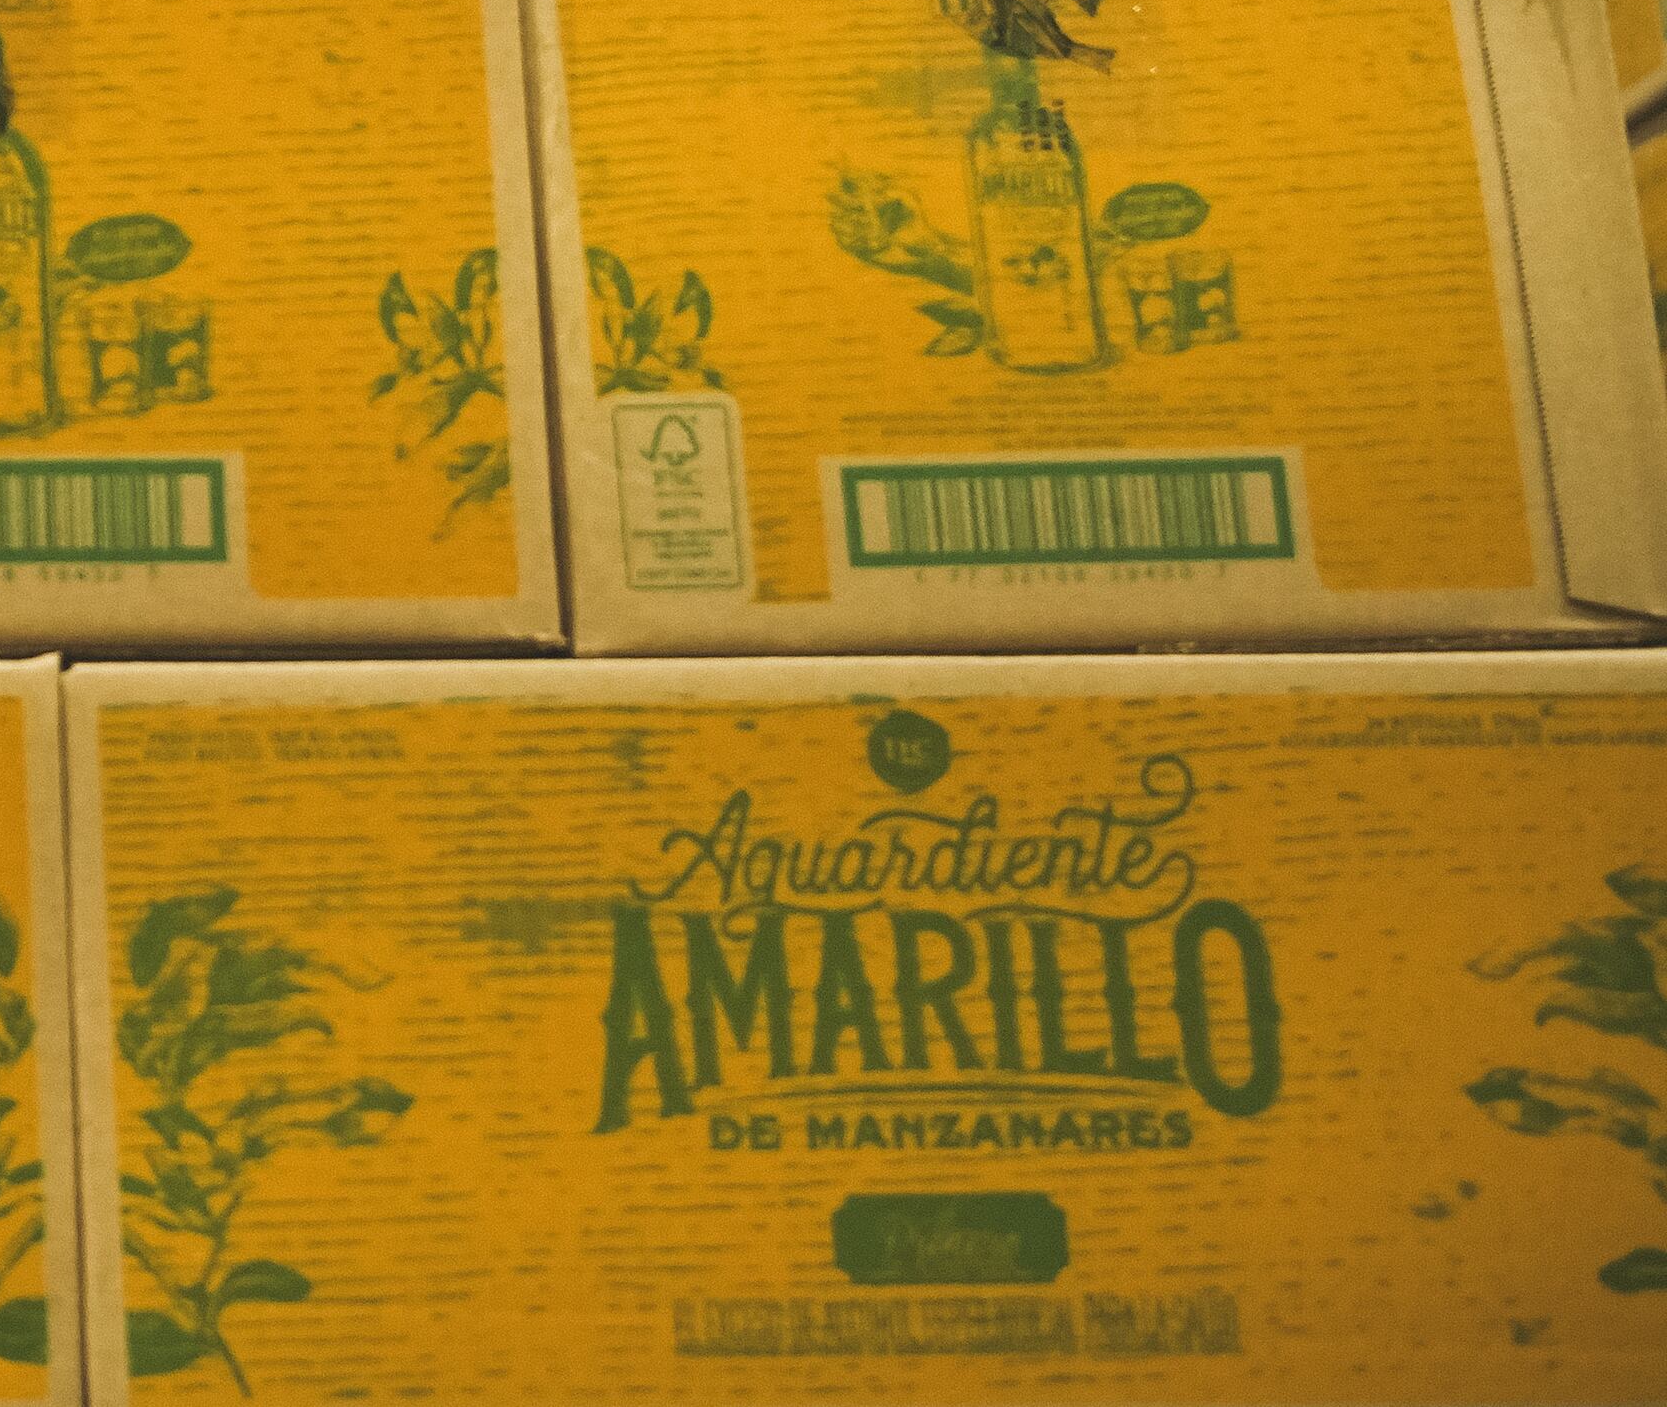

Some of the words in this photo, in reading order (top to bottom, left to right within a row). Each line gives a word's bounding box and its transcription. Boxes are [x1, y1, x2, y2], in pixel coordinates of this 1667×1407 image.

[626, 753, 1196, 943] Aguardiente
[591, 899, 1283, 1134] AMARILLO
[708, 1113, 782, 1151] DE
[807, 1109, 1194, 1153] MANZANARES
